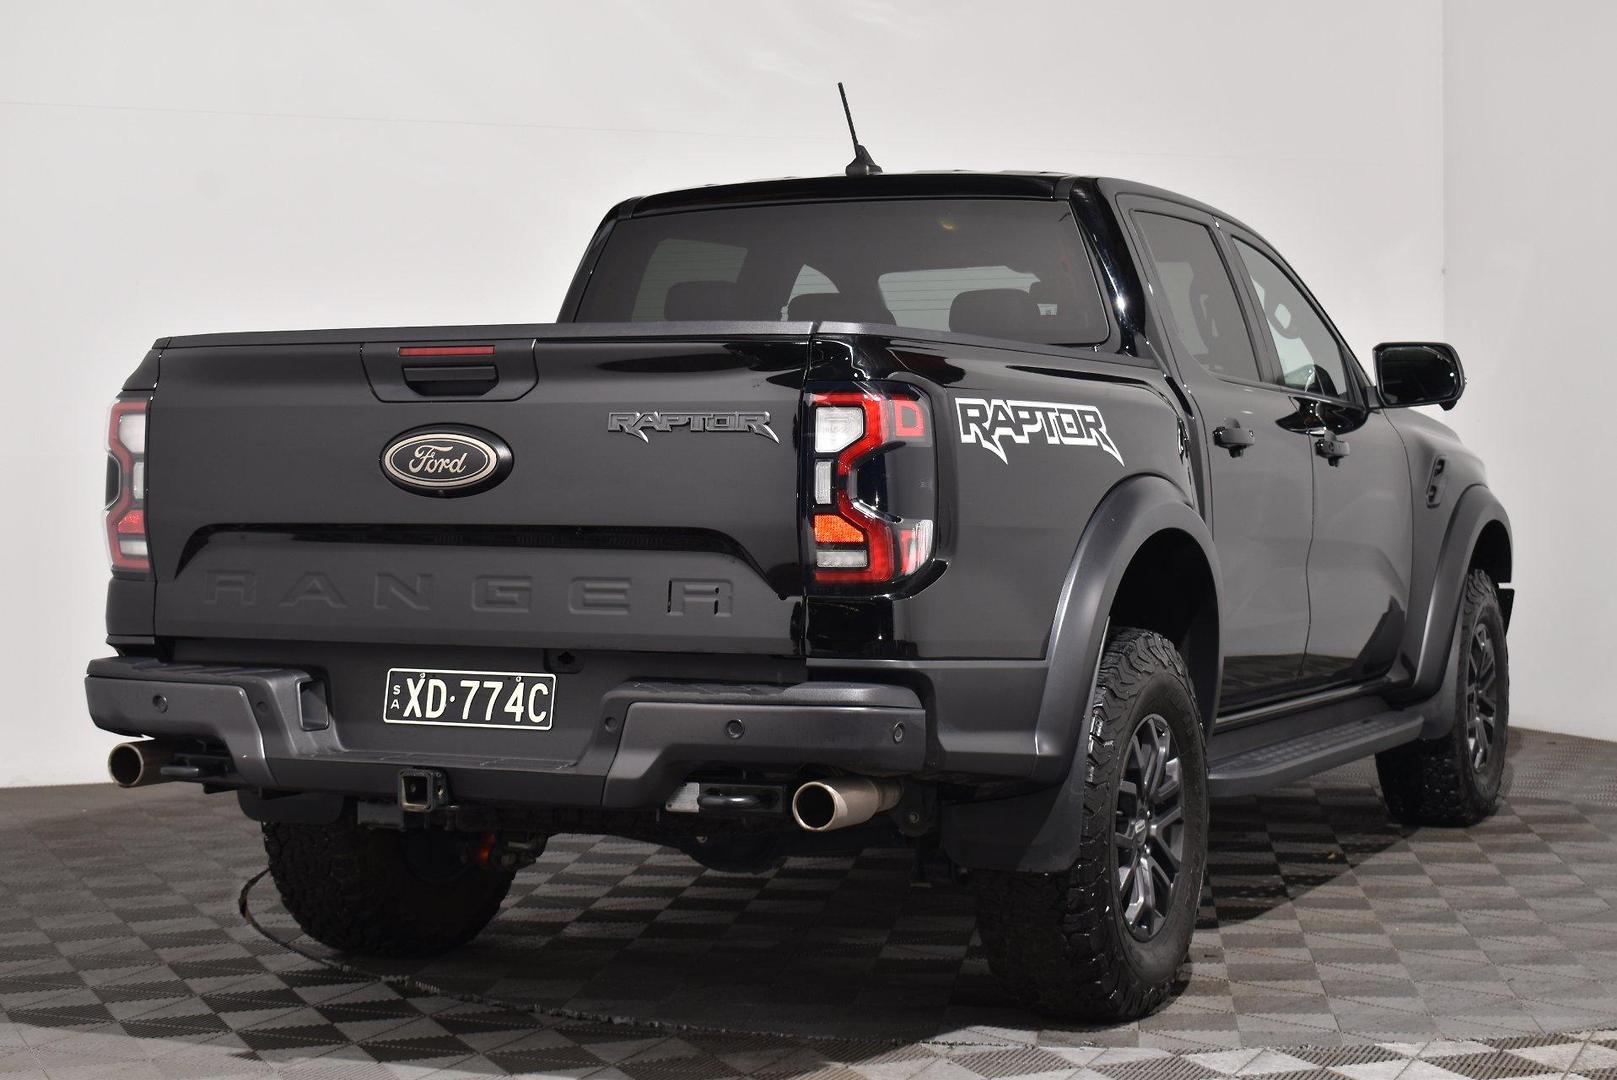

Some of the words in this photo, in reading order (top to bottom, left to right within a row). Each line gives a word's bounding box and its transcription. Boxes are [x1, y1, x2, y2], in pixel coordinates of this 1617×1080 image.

[607, 411, 780, 443] RAPTOR
[955, 397, 1125, 467] RAPTOR
[409, 445, 467, 473] Ford
[205, 570, 733, 617] RANGER
